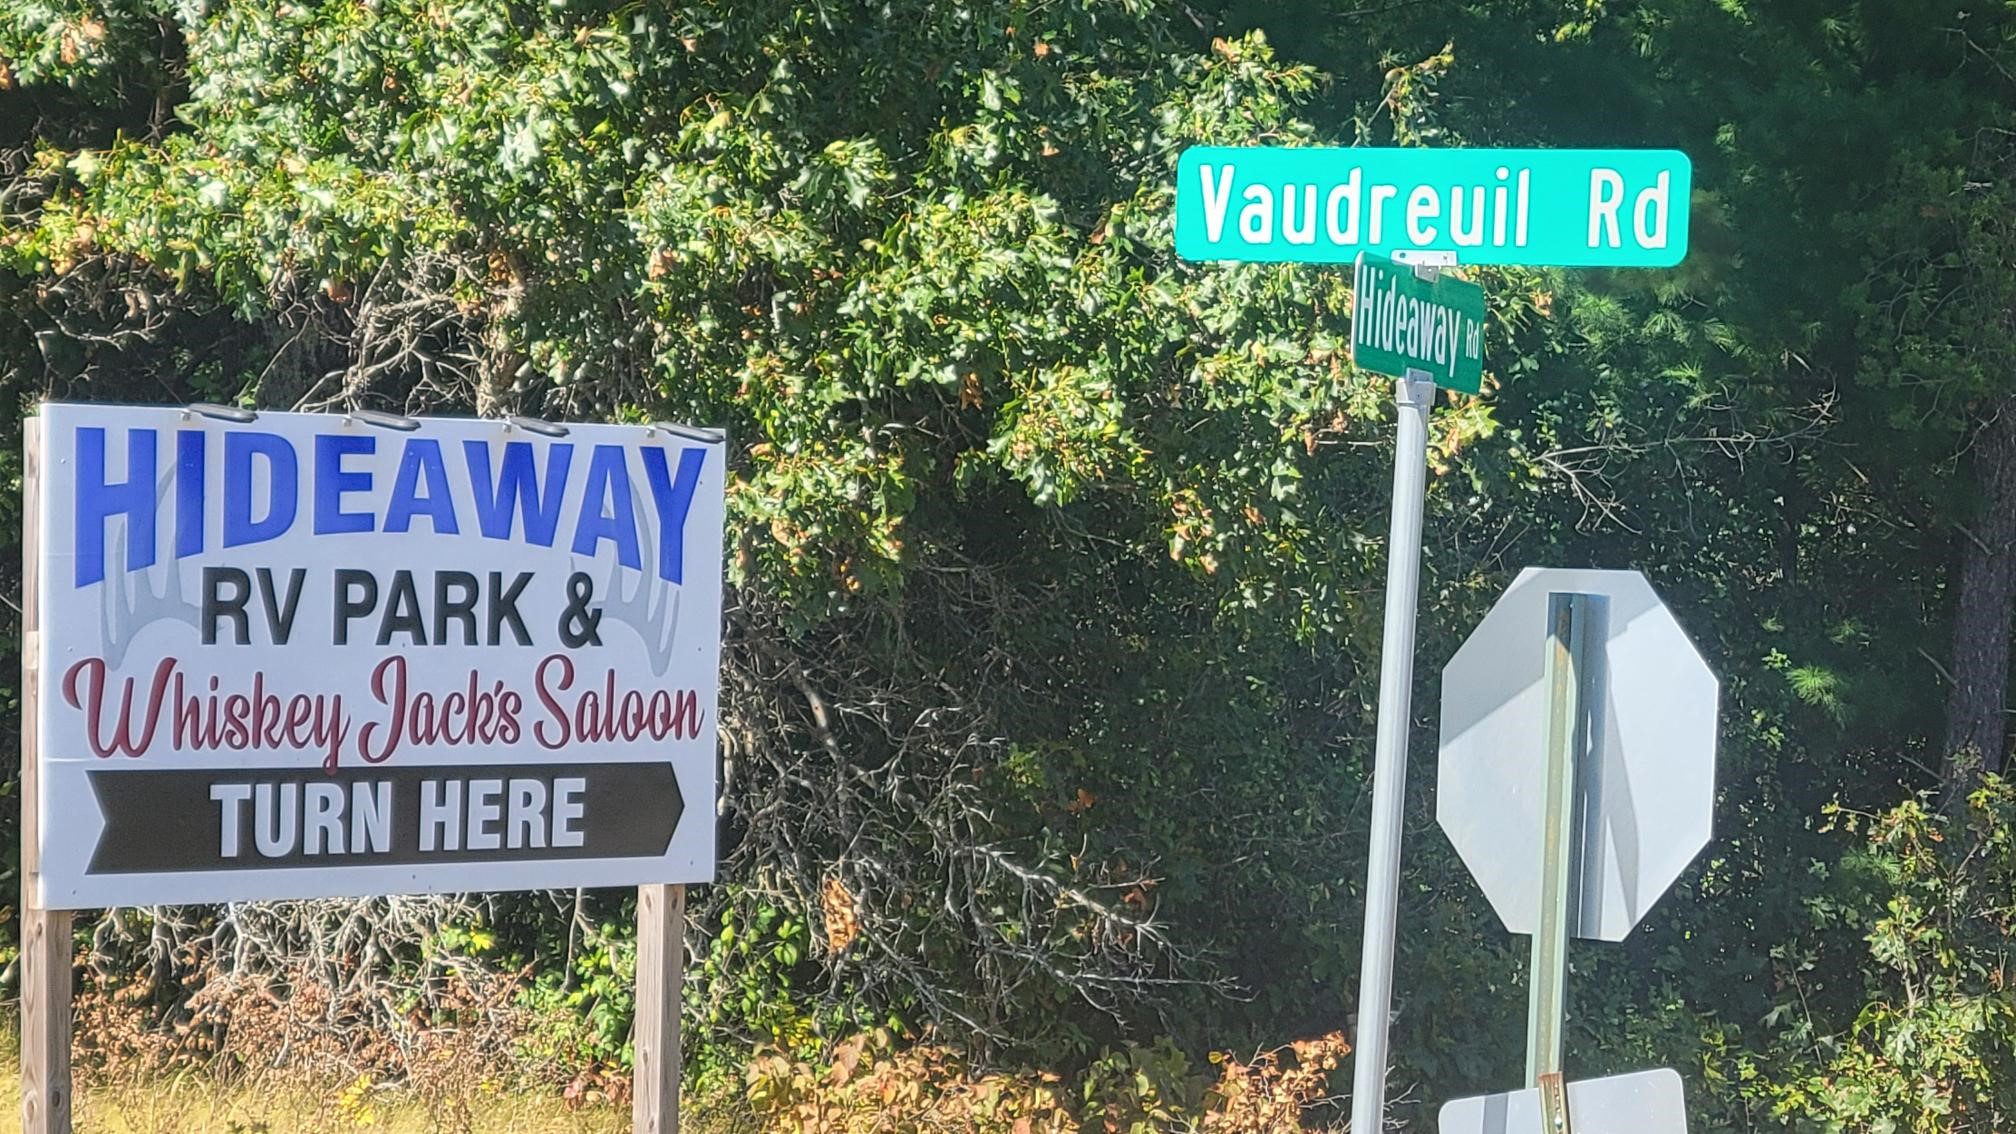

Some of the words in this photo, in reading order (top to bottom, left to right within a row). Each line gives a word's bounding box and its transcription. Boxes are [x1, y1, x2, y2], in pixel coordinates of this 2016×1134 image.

[1199, 164, 1530, 247] Vaudreuil
[1587, 168, 1670, 249] Rd
[1358, 264, 1461, 378] Hideaway
[1465, 318, 1480, 360] Rd
[74, 427, 708, 589] HIDEAWAY
[201, 567, 307, 646] RV
[333, 568, 535, 647] PARK
[558, 572, 603, 647] &
[62, 656, 350, 775] Whiskey
[358, 655, 524, 763] Jack's
[533, 654, 705, 750] Saloon
[210, 780, 393, 859] TURN
[419, 778, 588, 852] HERE
